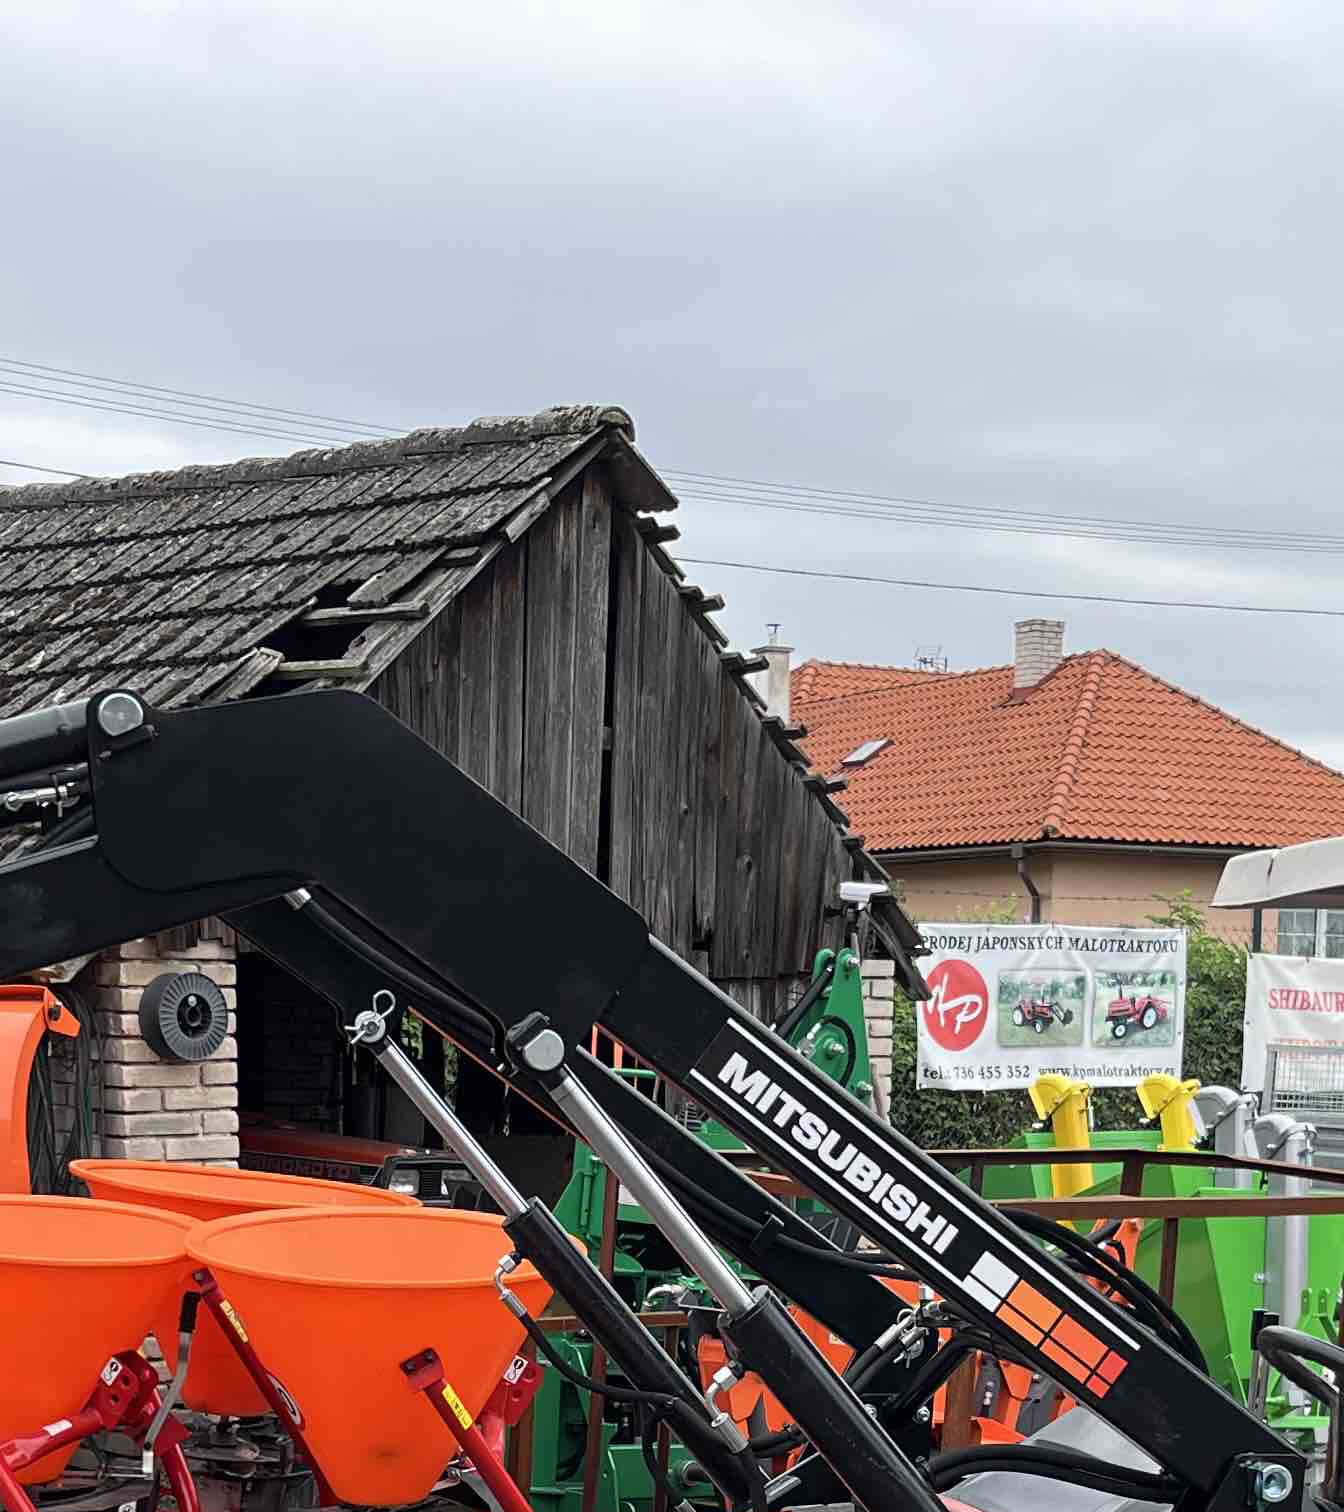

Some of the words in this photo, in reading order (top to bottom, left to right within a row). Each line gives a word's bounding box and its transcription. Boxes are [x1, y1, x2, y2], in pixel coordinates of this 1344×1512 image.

[921, 935, 972, 952] PRODEJ
[953, 1066, 975, 1079] 736
[978, 1065, 1001, 1079] 455
[1007, 1065, 1031, 1078] 352
[718, 1052, 959, 1254] MITSUBISHI
